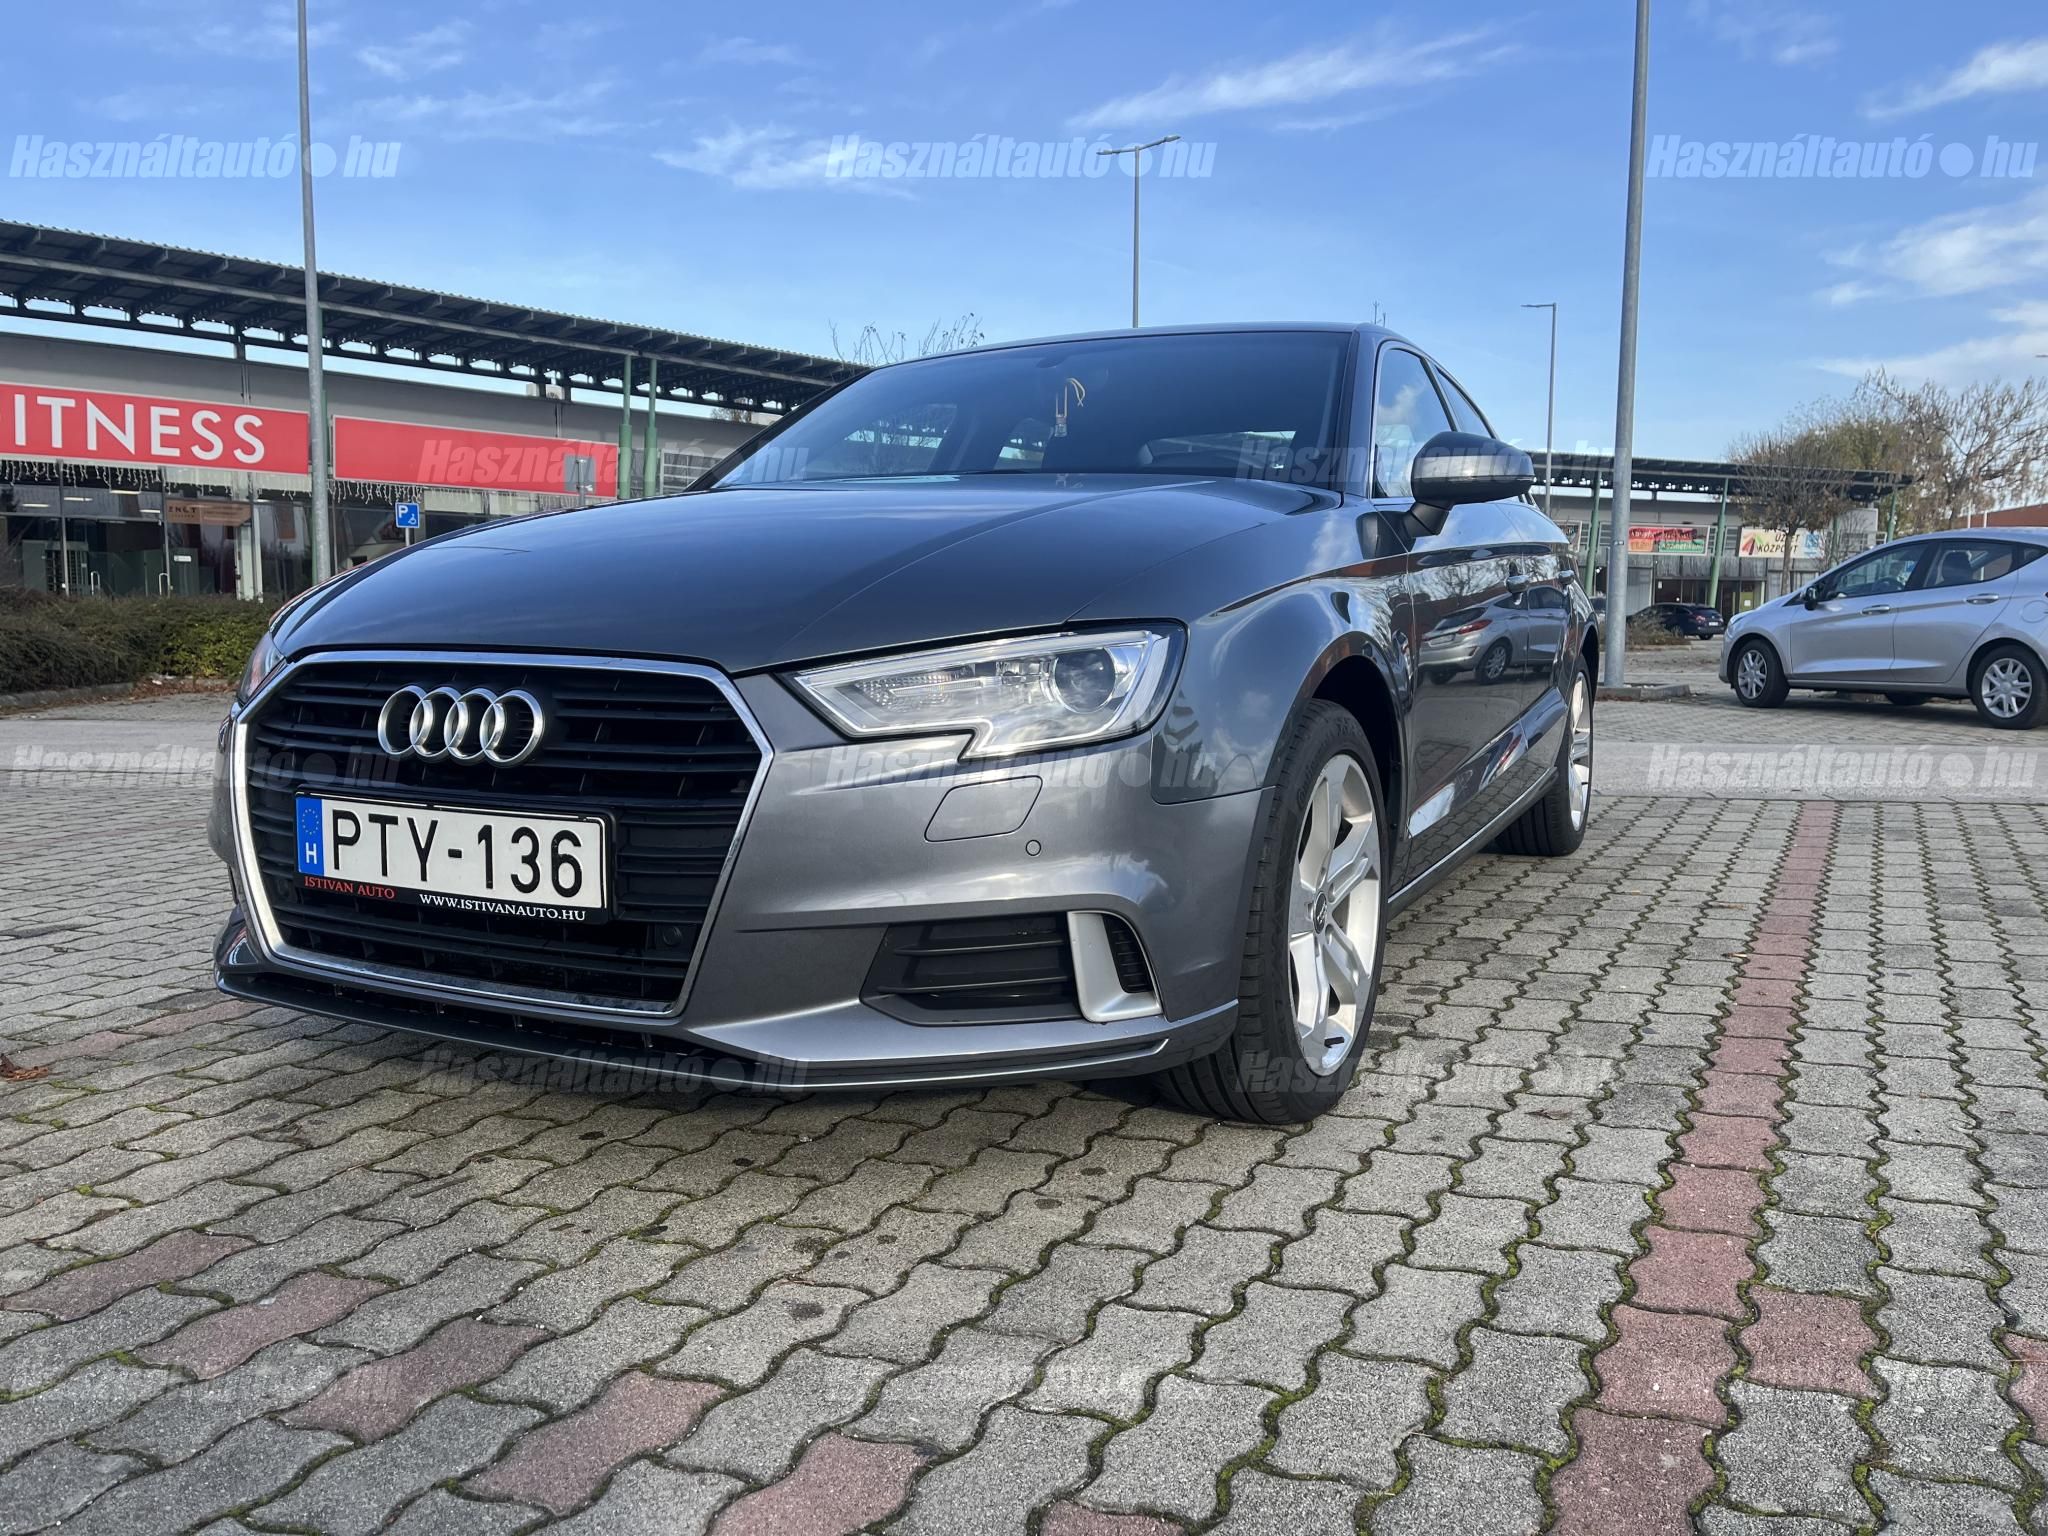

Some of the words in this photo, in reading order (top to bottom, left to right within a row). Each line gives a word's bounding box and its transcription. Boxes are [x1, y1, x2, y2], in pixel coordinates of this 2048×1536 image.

[398, 505, 408, 518] P
[305, 842, 317, 865] H
[332, 809, 583, 898] PTY-136
[304, 875, 354, 893] ISTIVAN
[357, 884, 395, 899] AUTO
[419, 893, 586, 921] WWW.ISTIVANAUTO.HU
